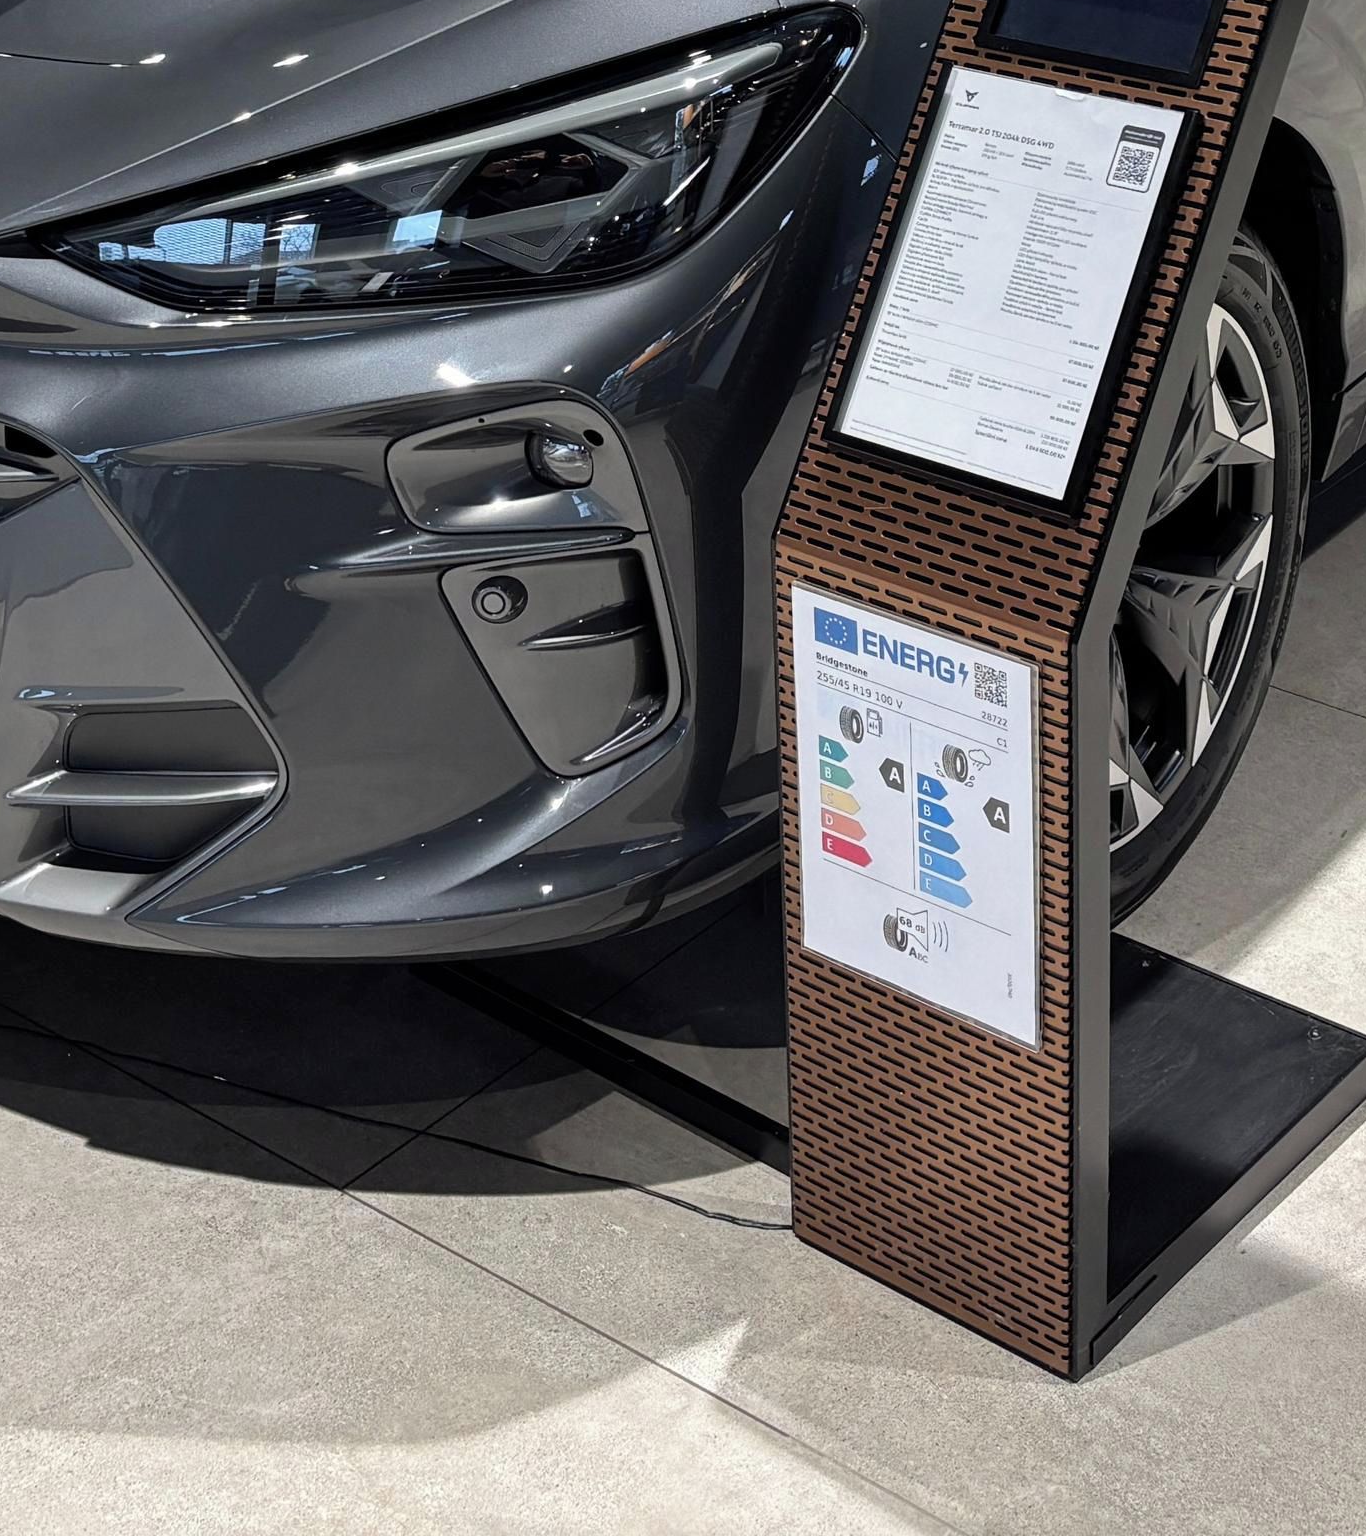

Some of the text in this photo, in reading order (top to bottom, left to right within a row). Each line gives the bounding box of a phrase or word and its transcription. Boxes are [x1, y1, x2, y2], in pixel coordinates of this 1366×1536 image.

[948, 120, 978, 134] Terramar
[1021, 137, 1036, 146] DSG
[1037, 140, 1055, 150] 4WD
[862, 629, 956, 684] ENERG
[816, 652, 869, 677] Bridgestone
[816, 670, 903, 710] 255/45 R19 100 V
[981, 711, 1009, 727] 28722
[823, 742, 832, 754] A
[996, 737, 1008, 748] C1
[825, 766, 832, 779] B
[889, 767, 902, 785] A
[922, 780, 932, 793] A
[923, 804, 931, 817] B
[994, 806, 1007, 825] A
[825, 814, 834, 826] D
[923, 829, 932, 842] C
[826, 838, 833, 851] E
[924, 853, 933, 865] D
[925, 878, 932, 891] E
[899, 916, 912, 928] 68
